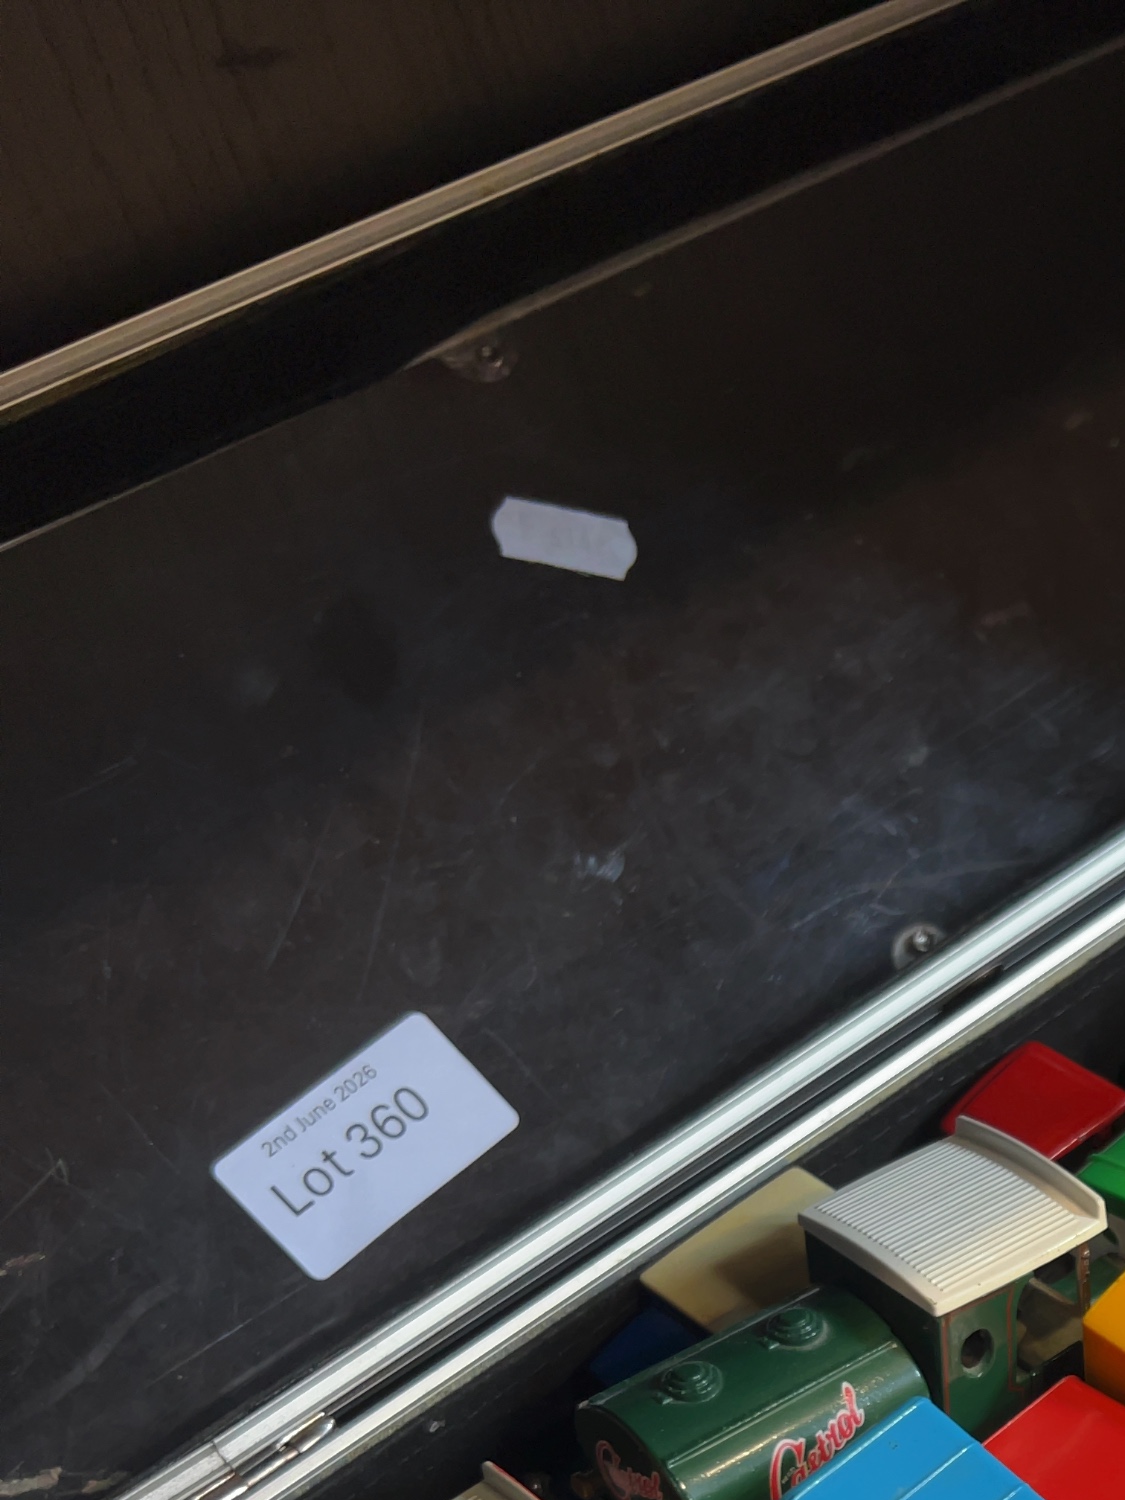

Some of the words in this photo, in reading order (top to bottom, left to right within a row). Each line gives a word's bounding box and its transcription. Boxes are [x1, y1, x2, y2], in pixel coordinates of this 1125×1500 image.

[260, 1125, 297, 1158] 2nd
[296, 1096, 336, 1134] June
[333, 1063, 378, 1103] 2026
[270, 1149, 355, 1218] Lot
[345, 1086, 429, 1160] 360
